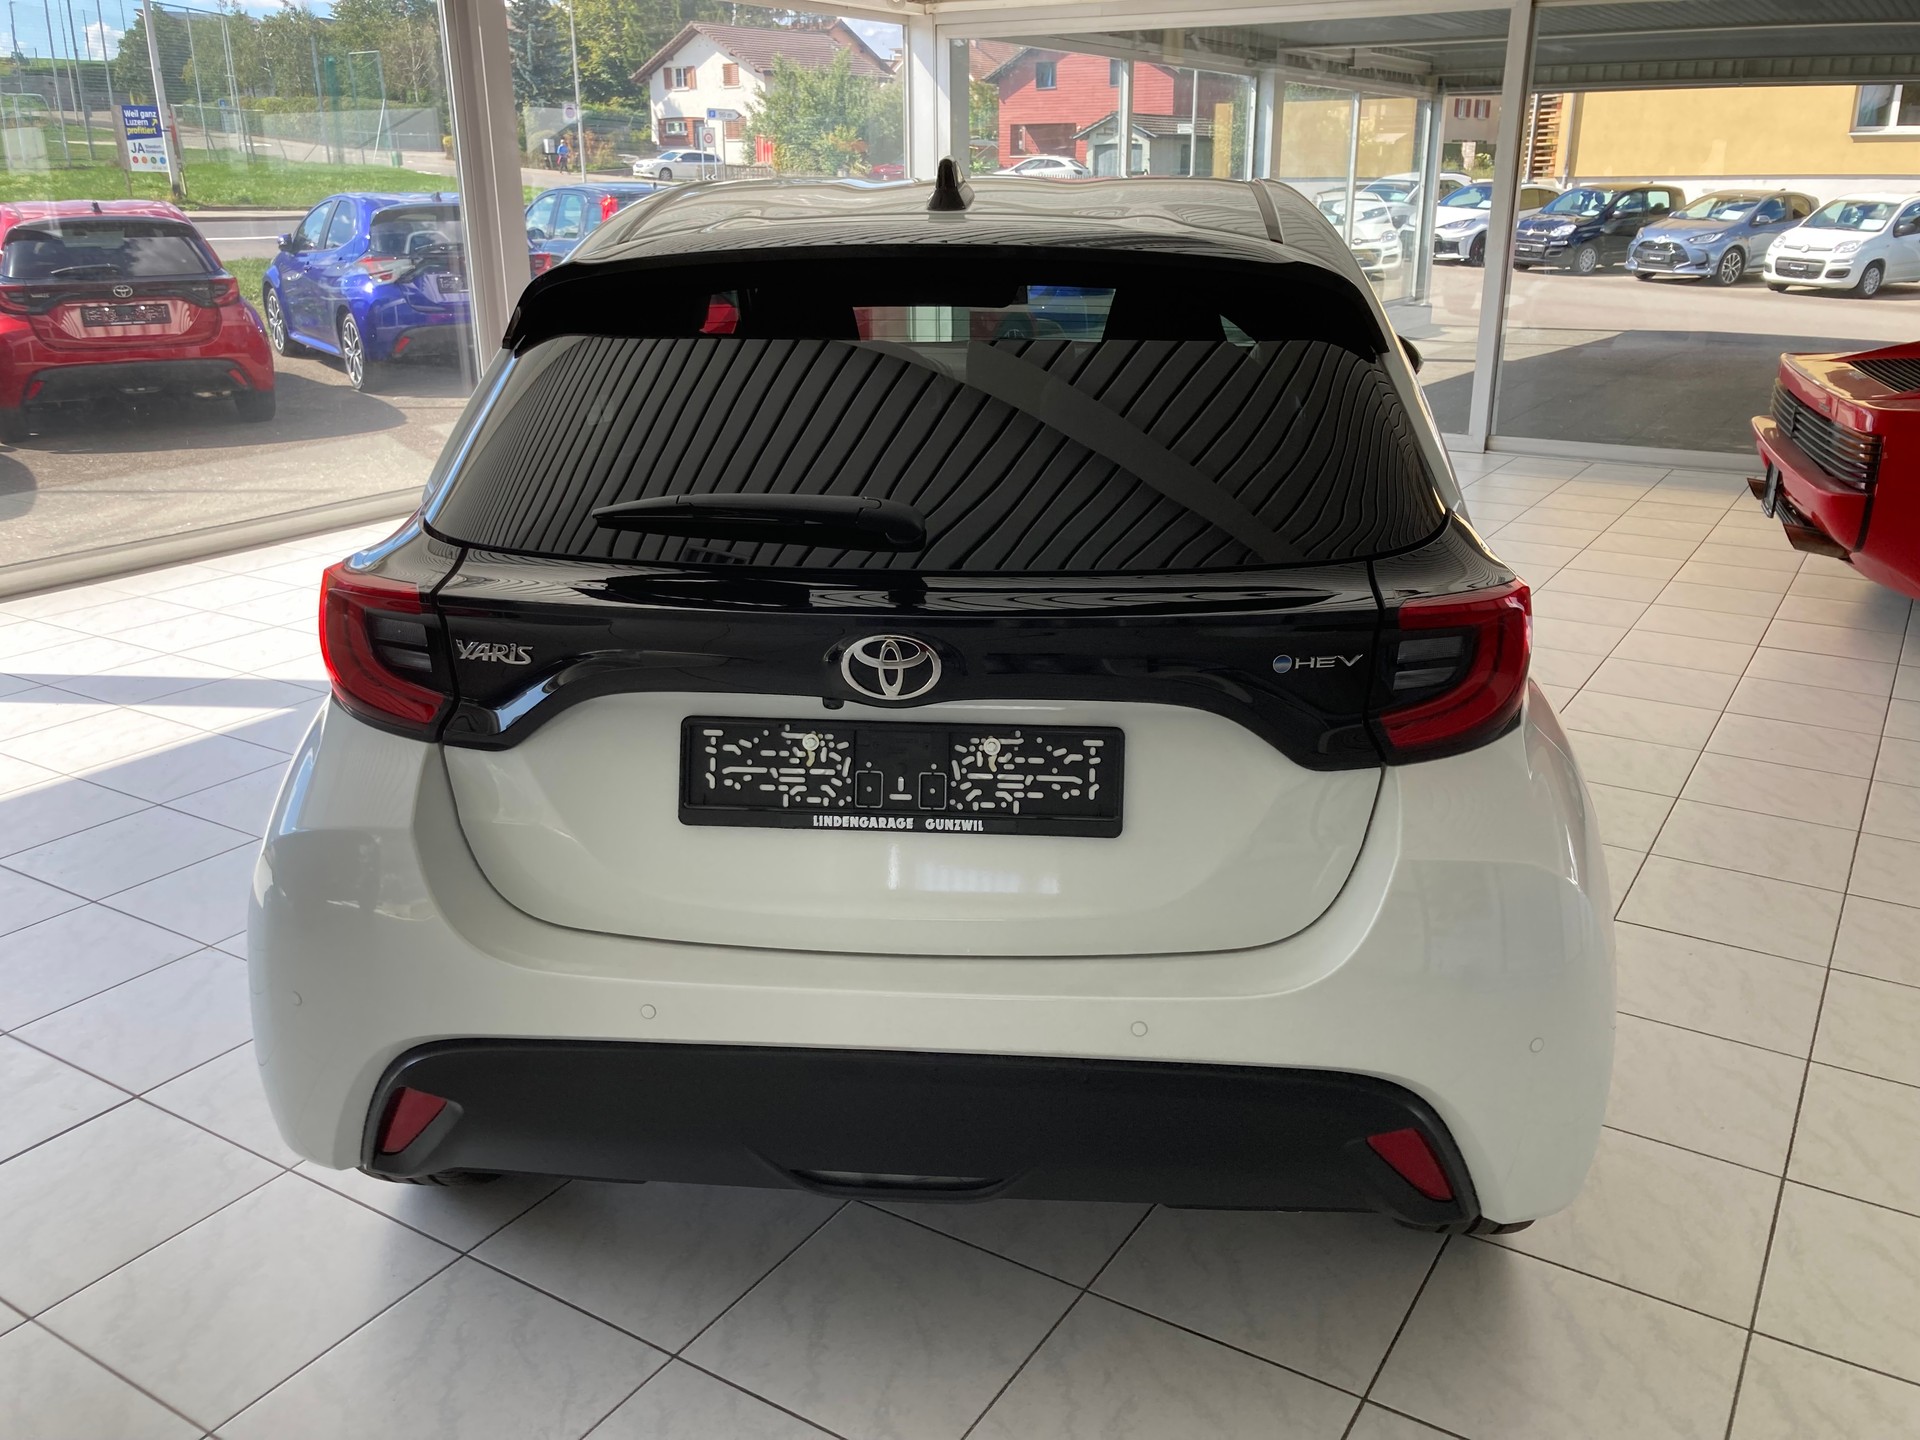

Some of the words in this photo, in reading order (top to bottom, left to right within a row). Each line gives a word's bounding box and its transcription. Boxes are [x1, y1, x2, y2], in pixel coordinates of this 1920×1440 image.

[124, 110, 139, 118] Weil
[140, 111, 157, 119] ganz
[125, 118, 149, 126] Luzern
[127, 127, 157, 135] profitiert
[131, 142, 146, 154] JA
[1295, 654, 1363, 669] HEV
[813, 815, 914, 829] LINDENGARAGE
[925, 818, 984, 831] GUNZWIL
